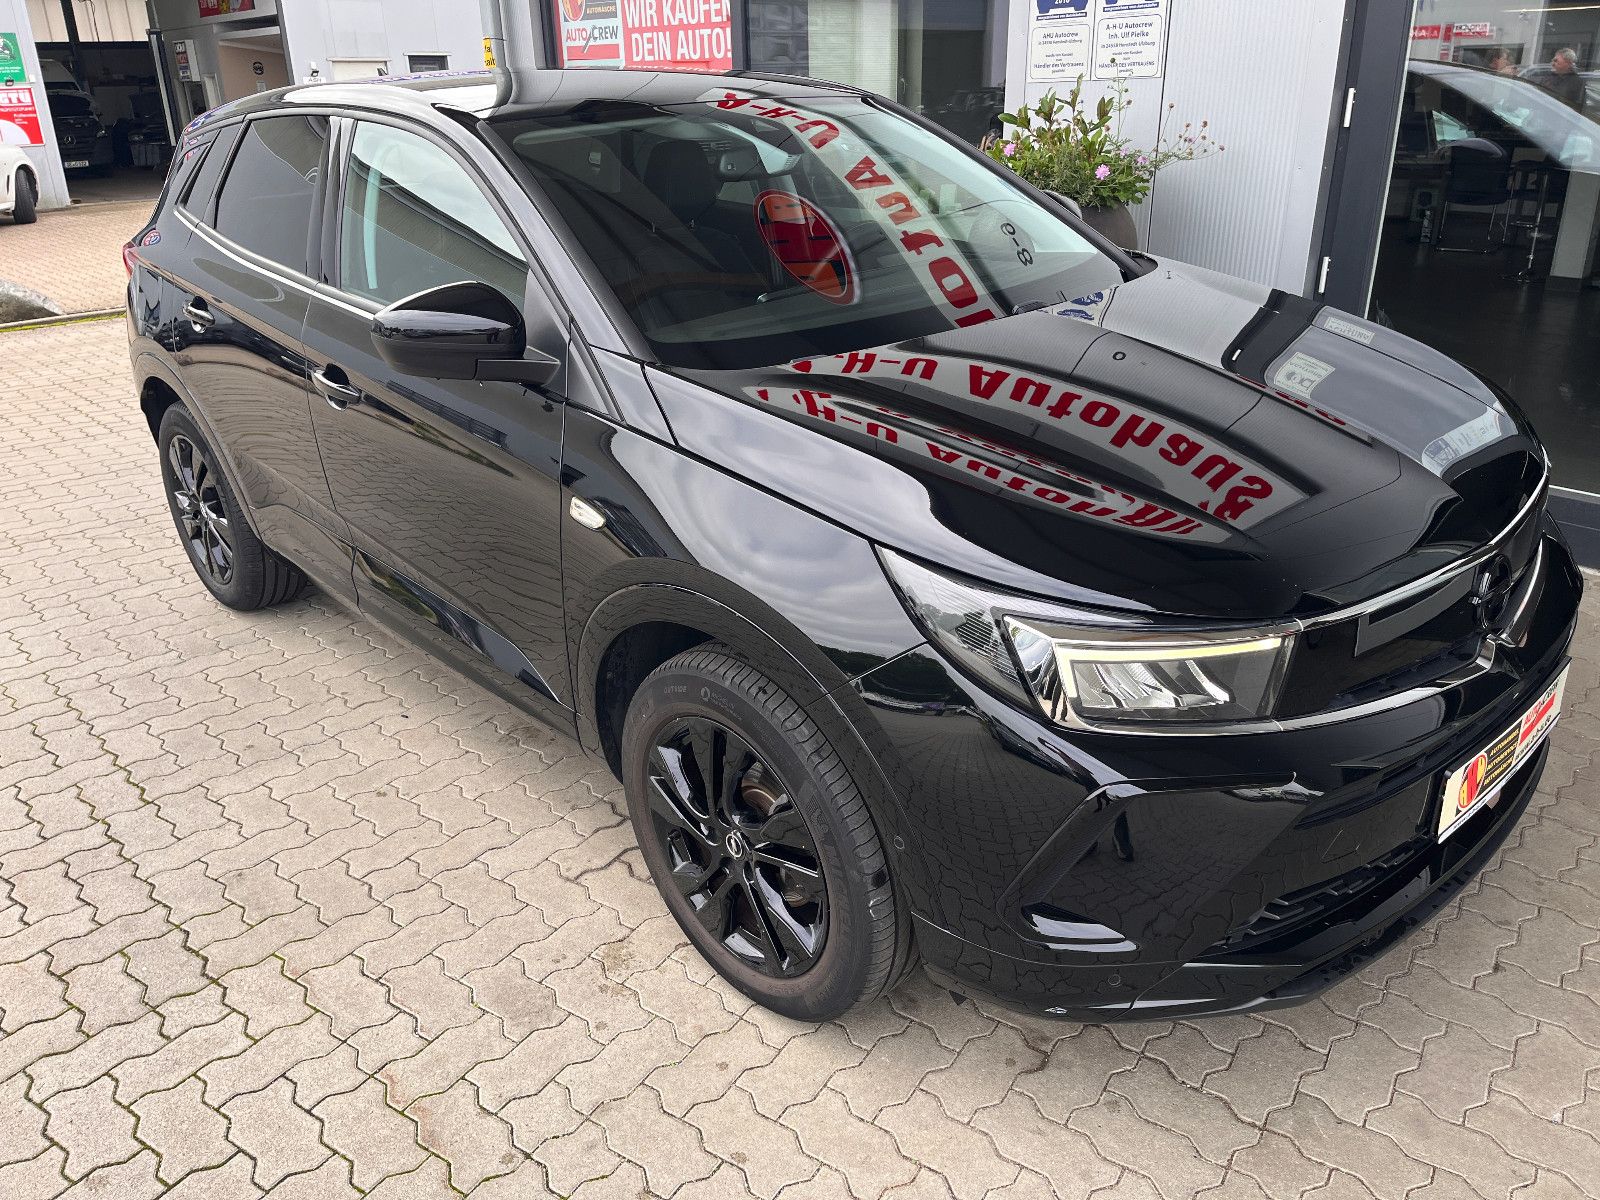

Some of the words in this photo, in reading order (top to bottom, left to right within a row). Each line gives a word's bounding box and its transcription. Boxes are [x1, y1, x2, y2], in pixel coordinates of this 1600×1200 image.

[624, 0, 658, 28] WIR
[662, 0, 731, 26] KAUFEN
[1124, 21, 1153, 29] Autocrew
[566, 28, 588, 42] AUTO
[591, 25, 618, 42] CREW
[631, 31, 672, 61] DEIN
[676, 27, 732, 60] AUTO!
